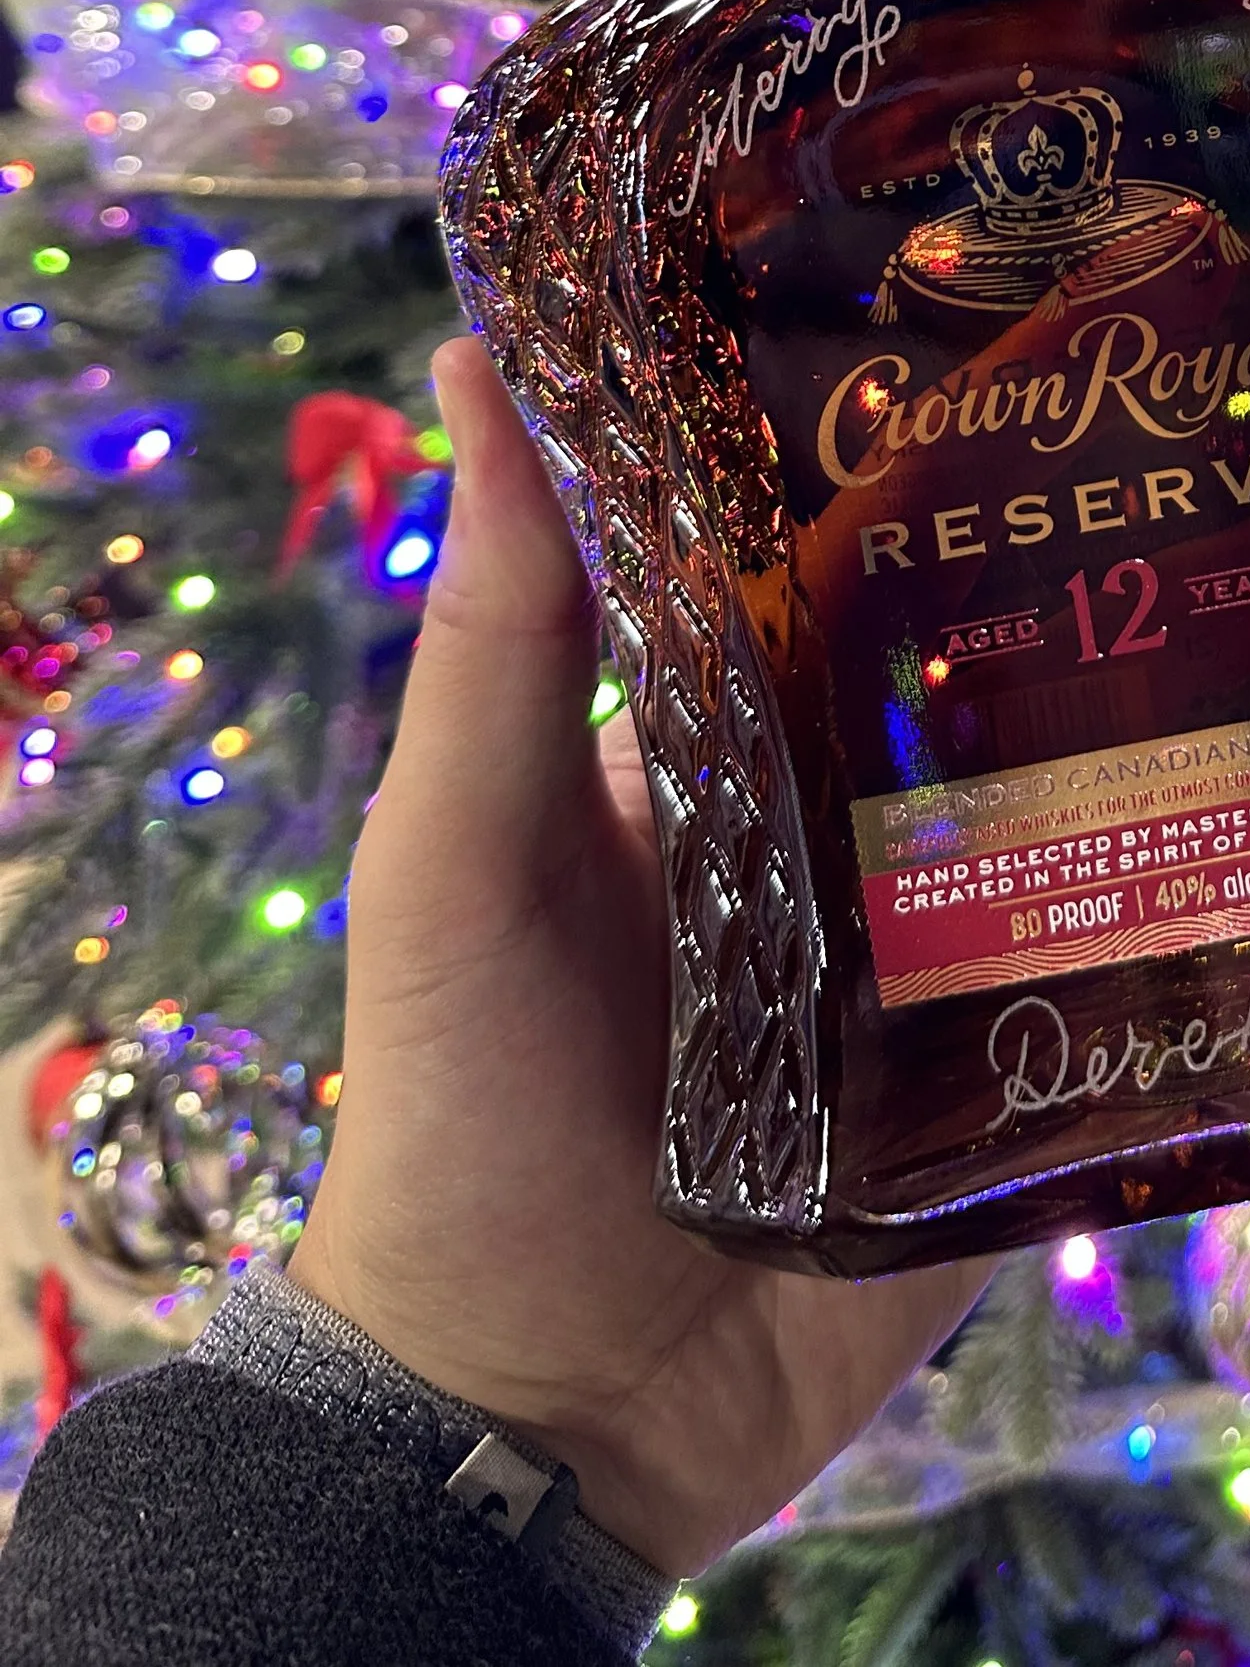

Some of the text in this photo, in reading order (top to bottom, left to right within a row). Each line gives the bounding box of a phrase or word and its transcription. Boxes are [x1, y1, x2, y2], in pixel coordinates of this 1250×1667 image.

[860, 123, 1224, 201] ESTD 1939
[816, 353, 1072, 489] Crown
[945, 617, 1041, 658] AGED
[1063, 557, 1168, 665] 12
[882, 774, 1056, 830] BLENDED
[1020, 801, 1095, 835] WHISKIES
[1098, 795, 1127, 816] FOR
[1129, 789, 1159, 810] THE
[1160, 776, 1222, 804] UTMOST
[893, 876, 1015, 915] CREATED
[1024, 868, 1051, 890] IN
[1059, 857, 1112, 882] THE
[1118, 839, 1204, 871] SPIRIT
[1211, 831, 1248, 853] OF
[896, 862, 970, 892] HAND
[978, 834, 1113, 877] SELECTED
[1120, 826, 1152, 848] BY
[1009, 907, 1043, 942] 80
[1047, 890, 1125, 935] PROOF
[1155, 870, 1218, 912] 40%
